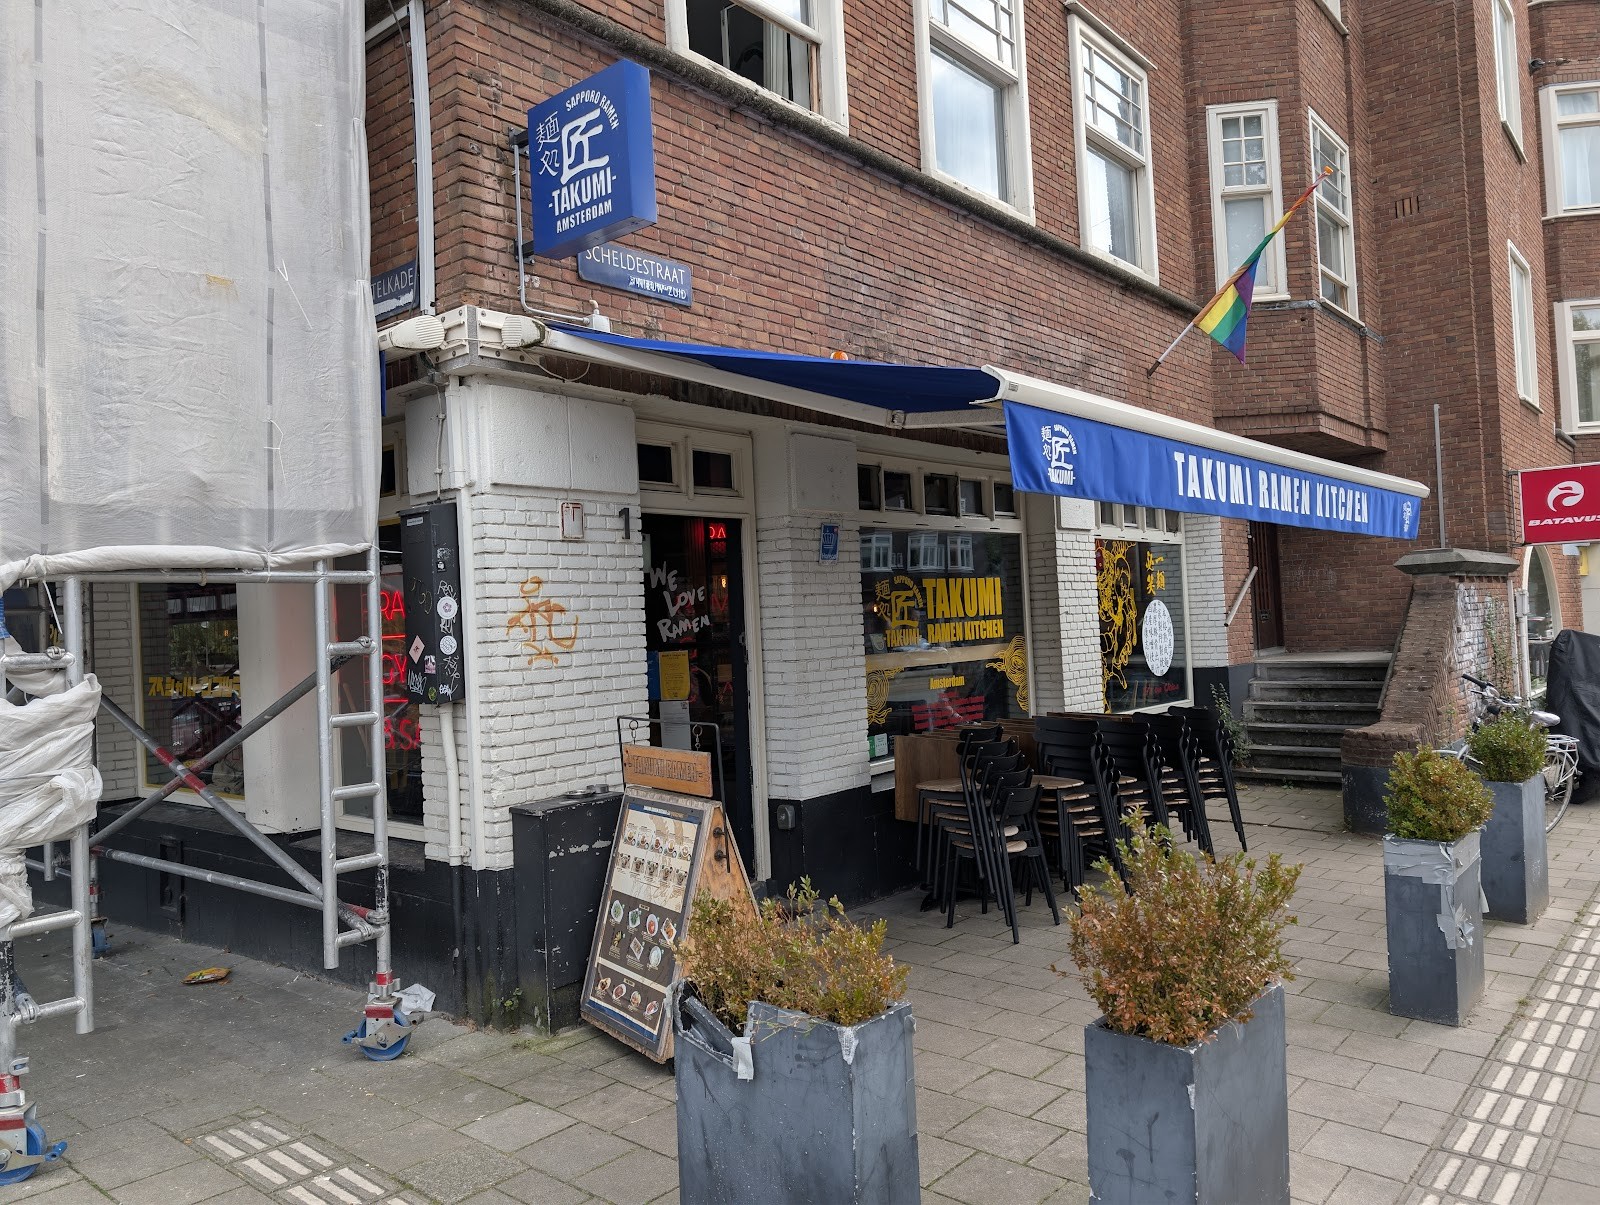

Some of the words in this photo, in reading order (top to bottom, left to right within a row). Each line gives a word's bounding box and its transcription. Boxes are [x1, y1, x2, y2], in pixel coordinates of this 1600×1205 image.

[565, 89, 601, 112] SAPPORO
[599, 94, 620, 130] RAMEN
[560, 108, 610, 185] 匠
[556, 199, 613, 234] AMSTERDAM
[585, 246, 686, 285] SCHELDESTRAAT
[1051, 436, 1074, 470] 匠
[1173, 451, 1253, 506] TAKUMI
[1258, 470, 1311, 515] RAMEN
[1316, 482, 1368, 523] KITCHEN
[618, 507, 630, 540] 1
[650, 560, 678, 592] WE
[663, 585, 706, 617] LOVE
[890, 590, 919, 629] 匠
[922, 577, 1003, 620] TAKUMI
[656, 614, 711, 643] RAMEN
[927, 621, 964, 644] RAMEN
[964, 619, 1004, 641] KITCHEN
[929, 675, 965, 690] Amsterdam
